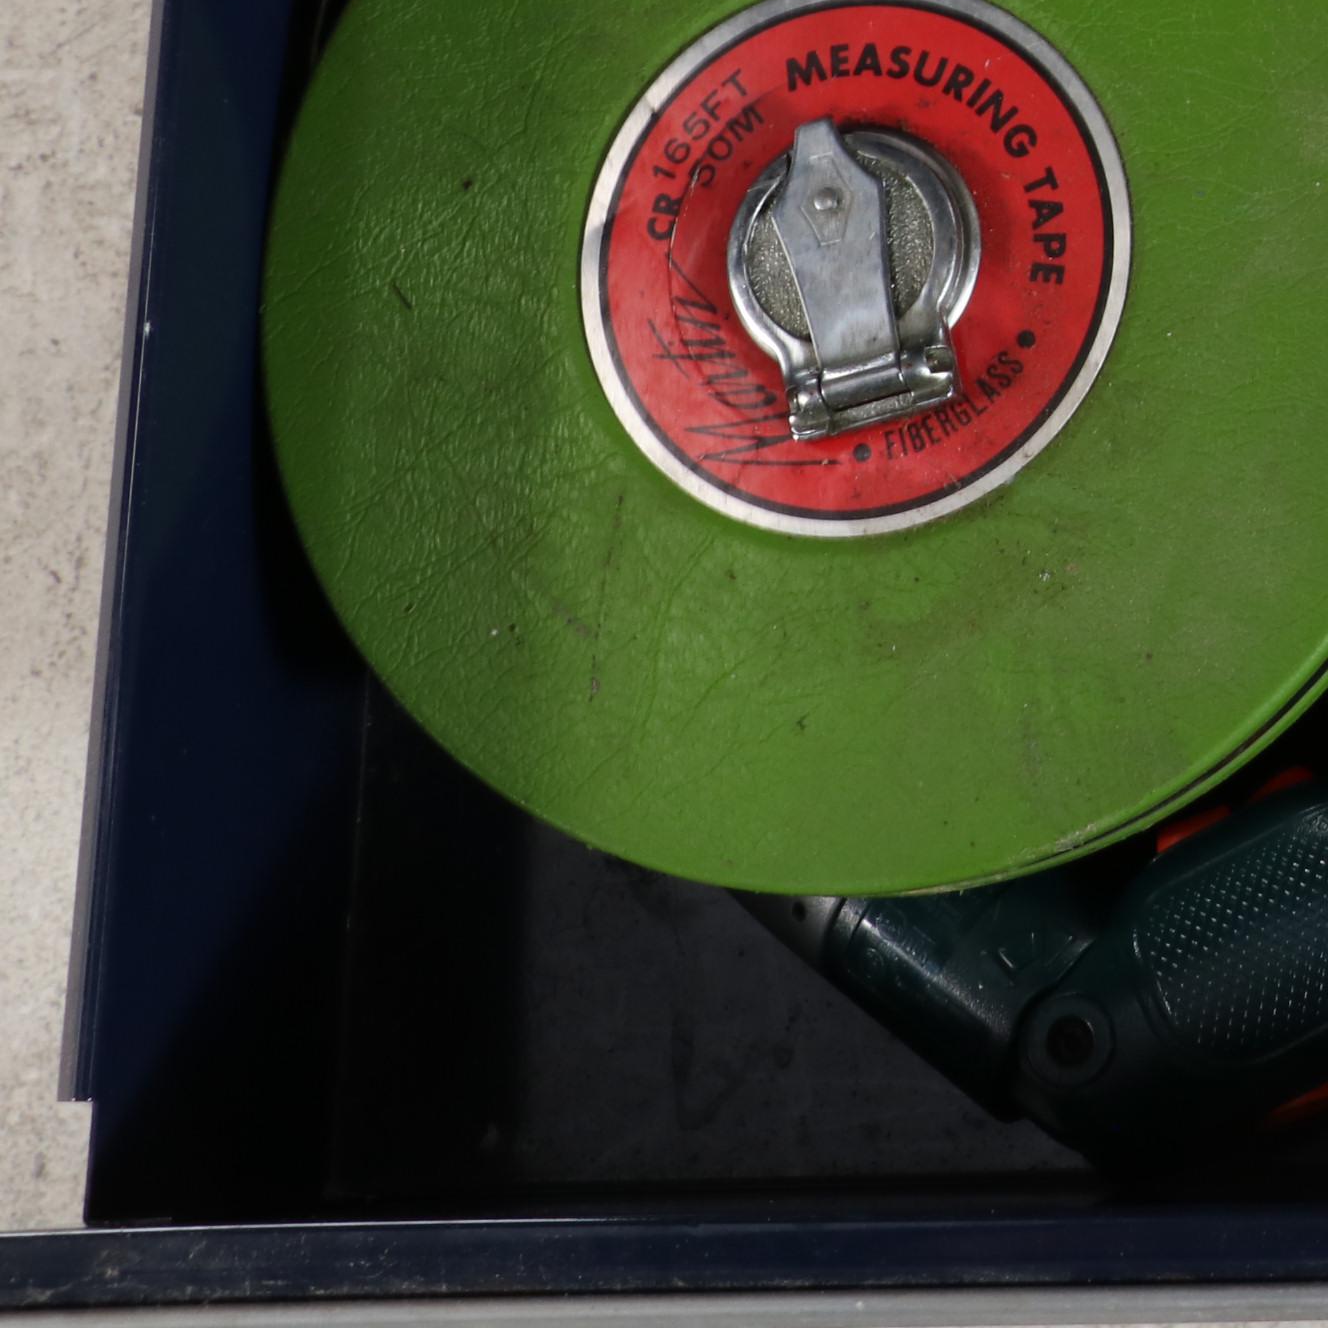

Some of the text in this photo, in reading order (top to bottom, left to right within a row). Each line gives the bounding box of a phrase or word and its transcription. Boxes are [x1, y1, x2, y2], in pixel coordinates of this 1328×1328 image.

[689, 103, 765, 189] 50M
[785, 43, 1066, 286] MEASURING TAPE
[647, 192, 683, 242] CR
[883, 353, 1024, 460] FIBERGLASS
